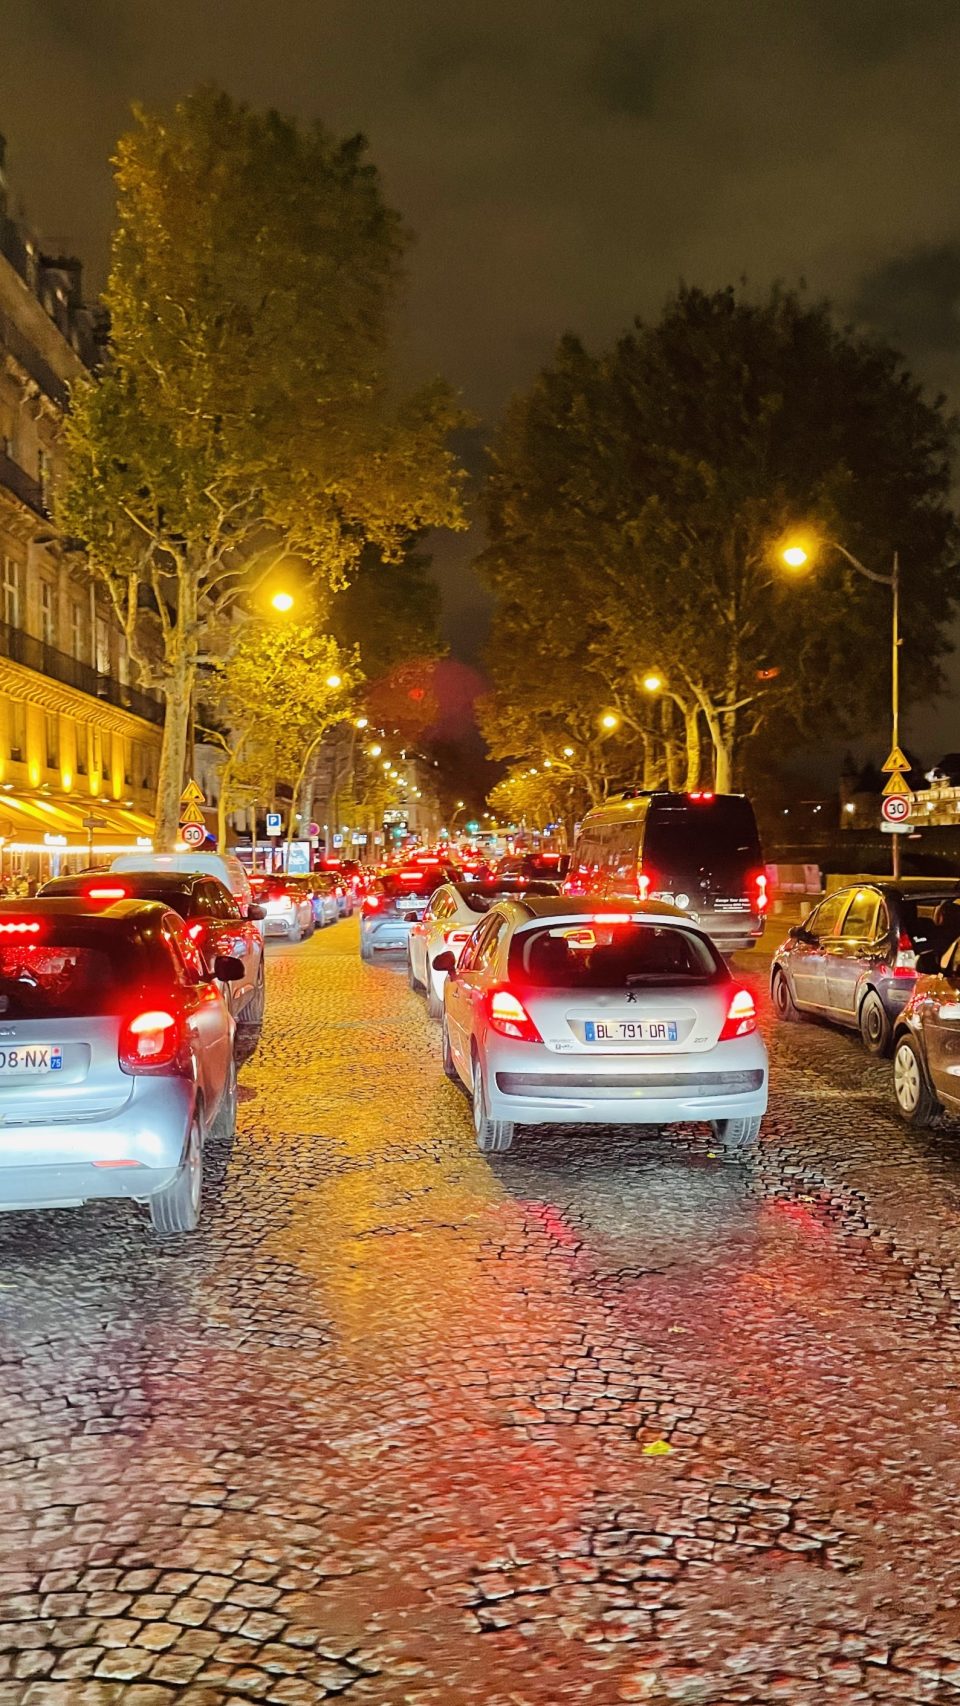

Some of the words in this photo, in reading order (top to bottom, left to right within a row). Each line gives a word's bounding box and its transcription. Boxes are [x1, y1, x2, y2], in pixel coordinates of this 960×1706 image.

[889, 803, 904, 815] 30
[270, 816, 278, 825] P
[186, 830, 200, 840] 30
[51, 1058, 61, 1068] 75
